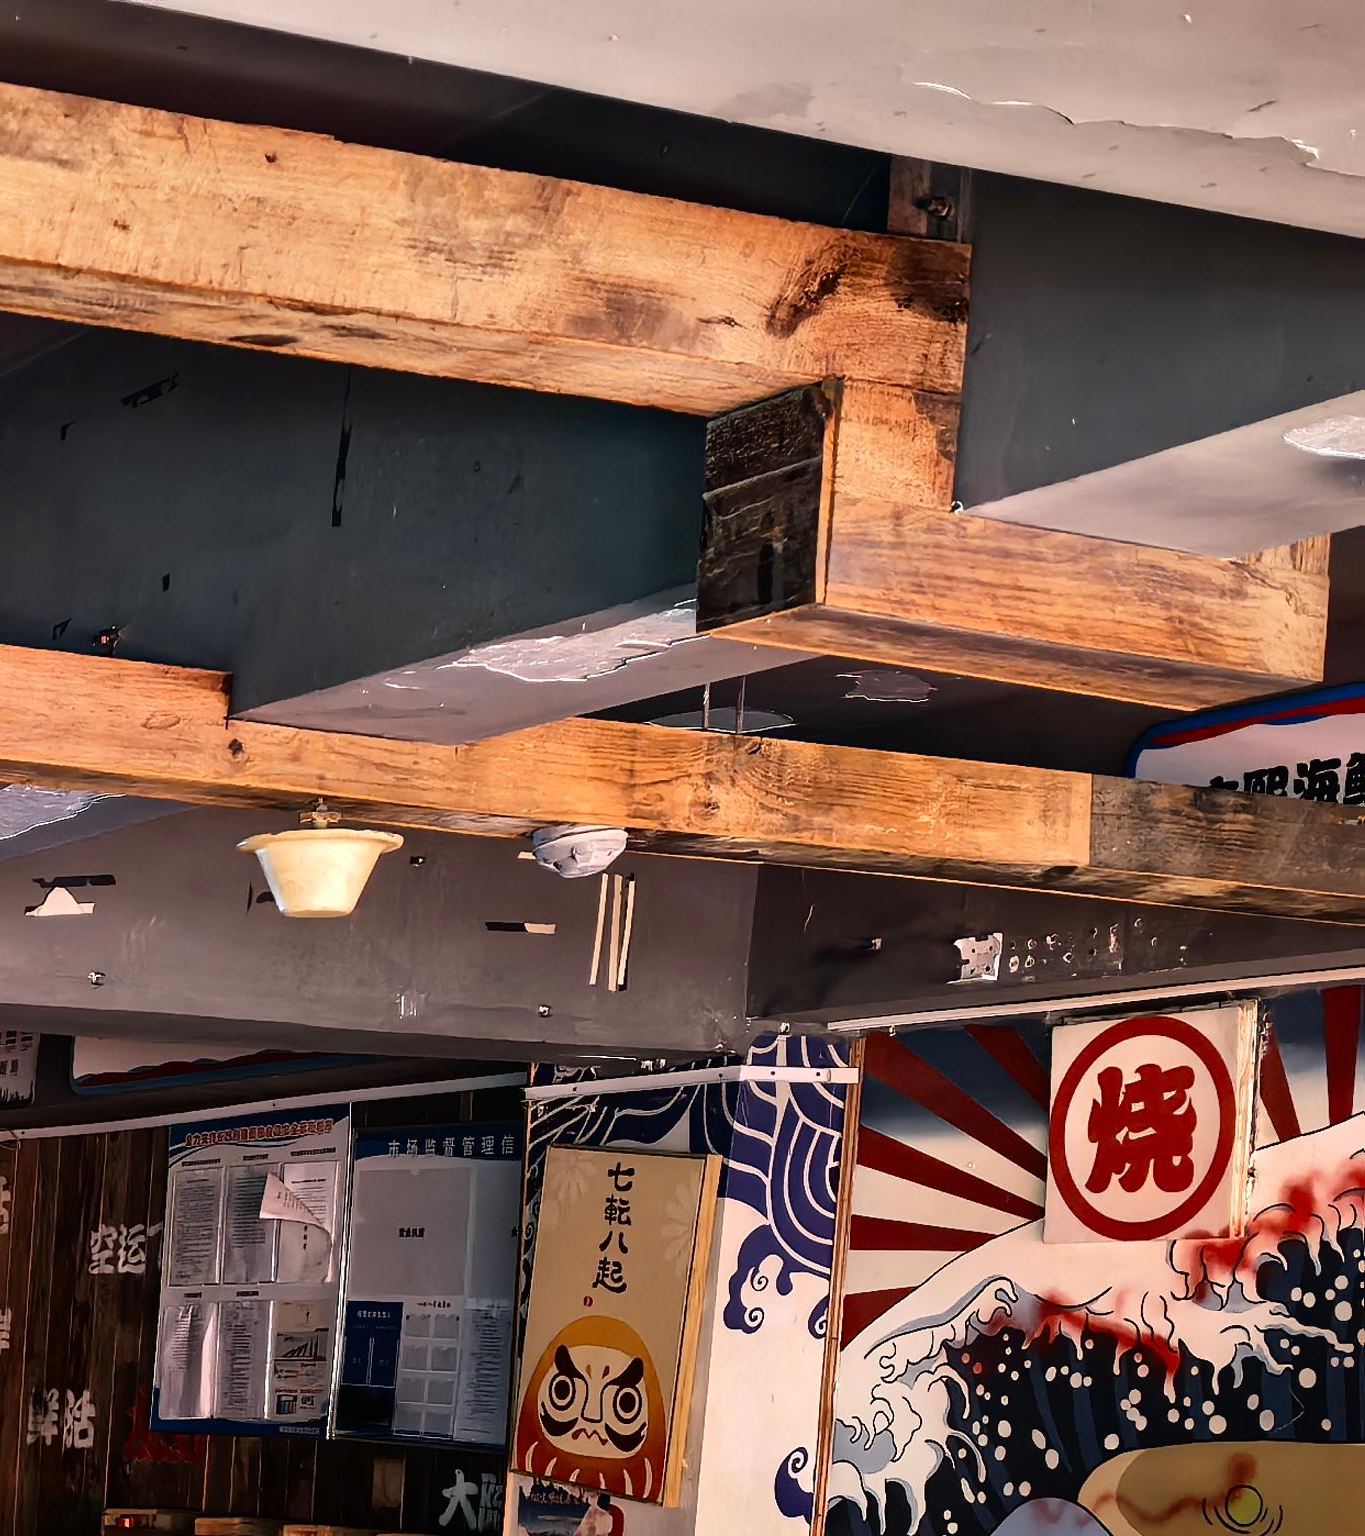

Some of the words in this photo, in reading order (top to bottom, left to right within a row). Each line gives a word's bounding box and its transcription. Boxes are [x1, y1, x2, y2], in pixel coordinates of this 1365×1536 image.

[1085, 1062, 1197, 1195] 烧
[88, 1220, 164, 1275] 空运
[592, 1161, 635, 1294] 七転八起
